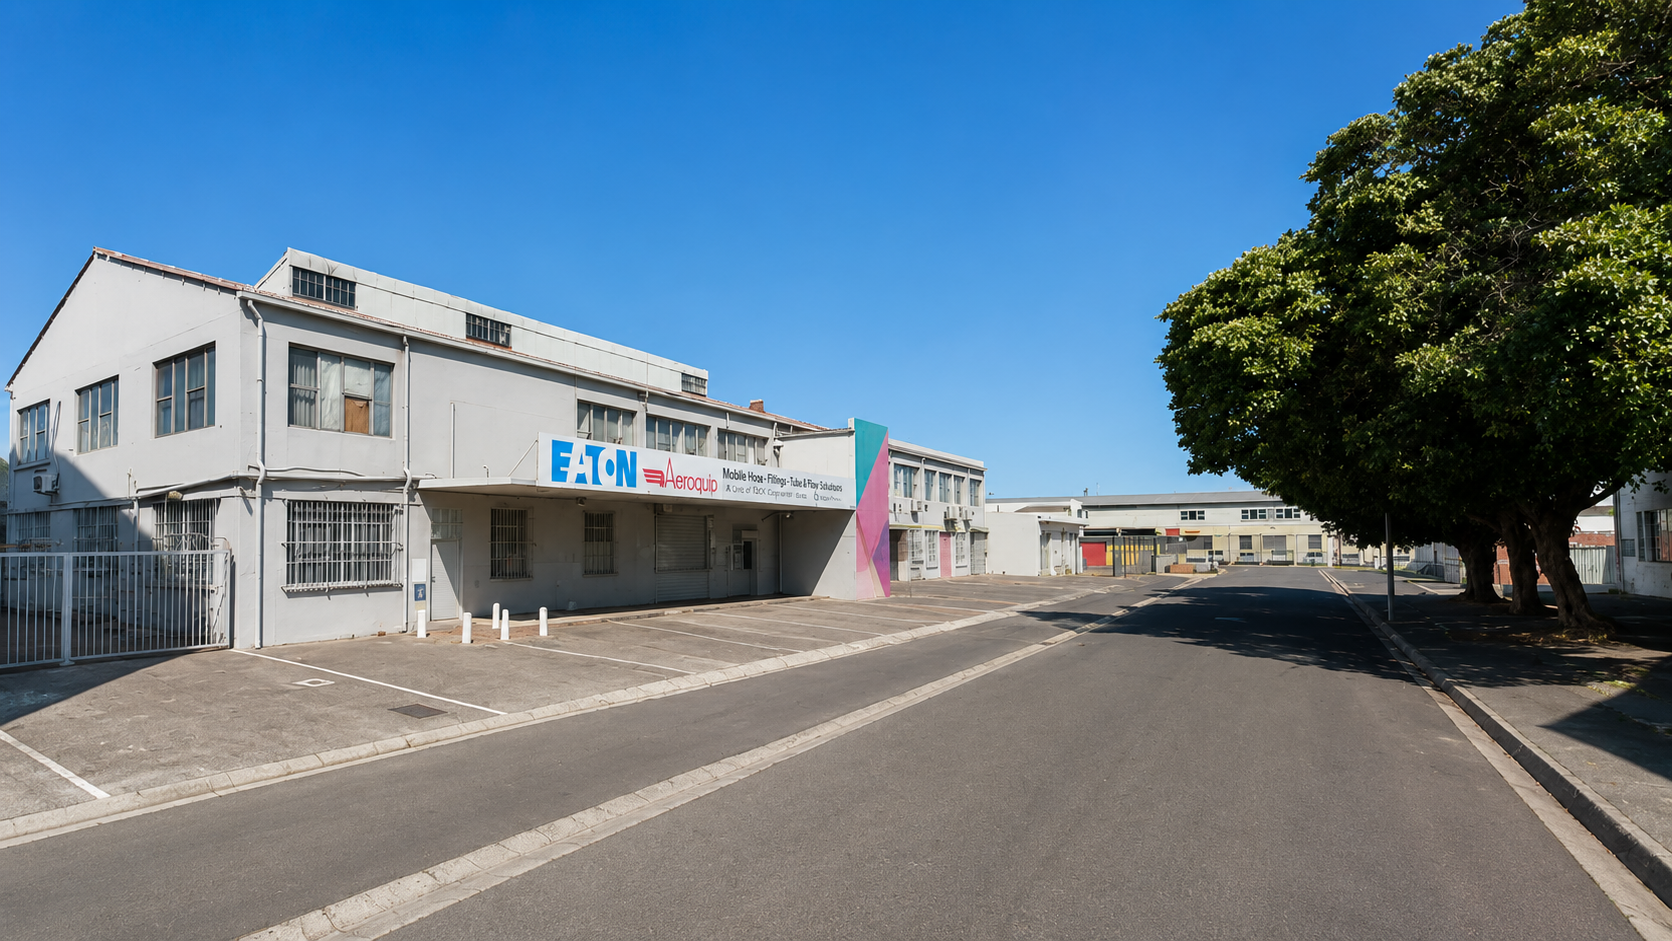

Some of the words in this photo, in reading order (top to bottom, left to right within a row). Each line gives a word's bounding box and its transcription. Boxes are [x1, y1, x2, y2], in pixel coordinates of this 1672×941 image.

[551, 439, 637, 488] EATON
[664, 457, 718, 495] Aeroquip
[723, 468, 746, 481] Mobile
